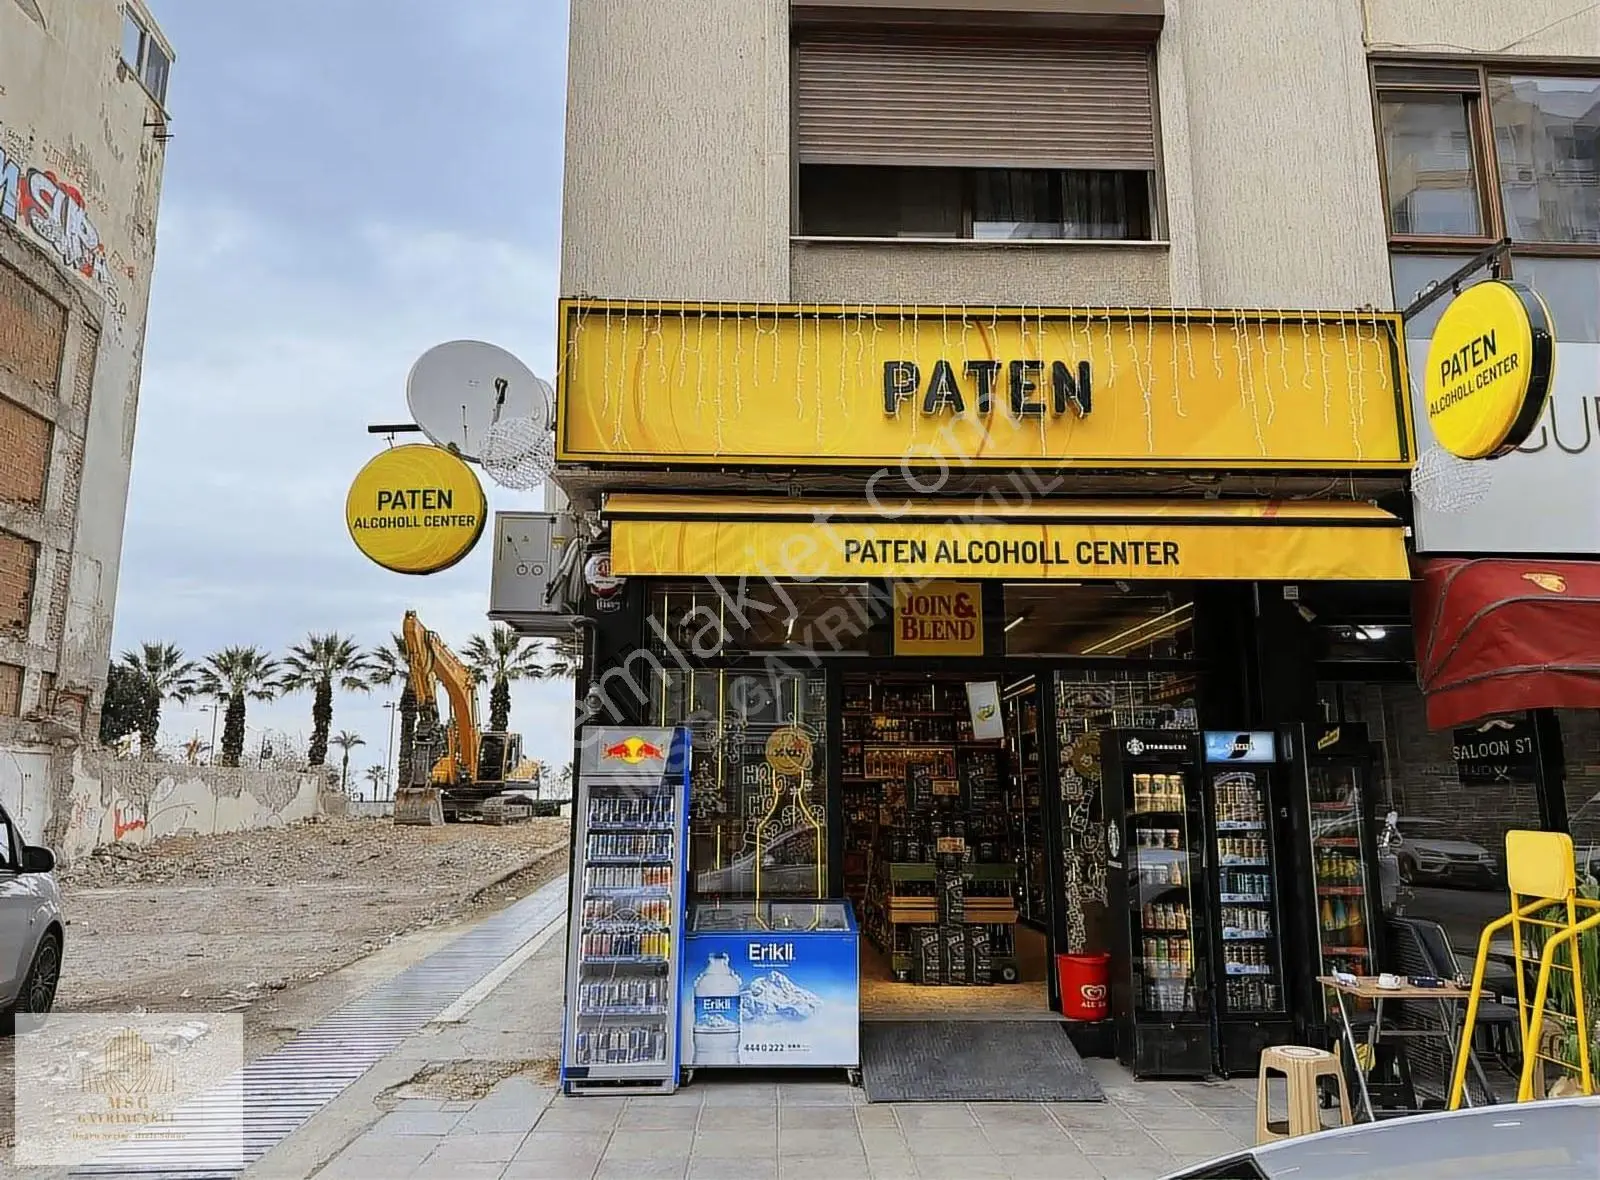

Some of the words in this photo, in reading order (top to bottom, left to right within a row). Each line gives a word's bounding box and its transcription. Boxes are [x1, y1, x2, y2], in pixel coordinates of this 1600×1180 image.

[1440, 328, 1497, 387] PATEN
[883, 360, 1093, 418] PATEN
[1430, 382, 1474, 418] ALCOHOLL
[1476, 353, 1519, 390] CENTER
[377, 490, 453, 511] PATEN
[354, 516, 421, 529] ALCOHOLL
[424, 515, 475, 527] CENTER
[844, 539, 927, 563] PATEN
[934, 540, 1069, 564] ALCOHOLL
[1076, 541, 1180, 565] CENTER
[901, 617, 975, 641] BLEND
[1452, 739, 1510, 760] SALOON
[749, 943, 795, 961] Erikli
